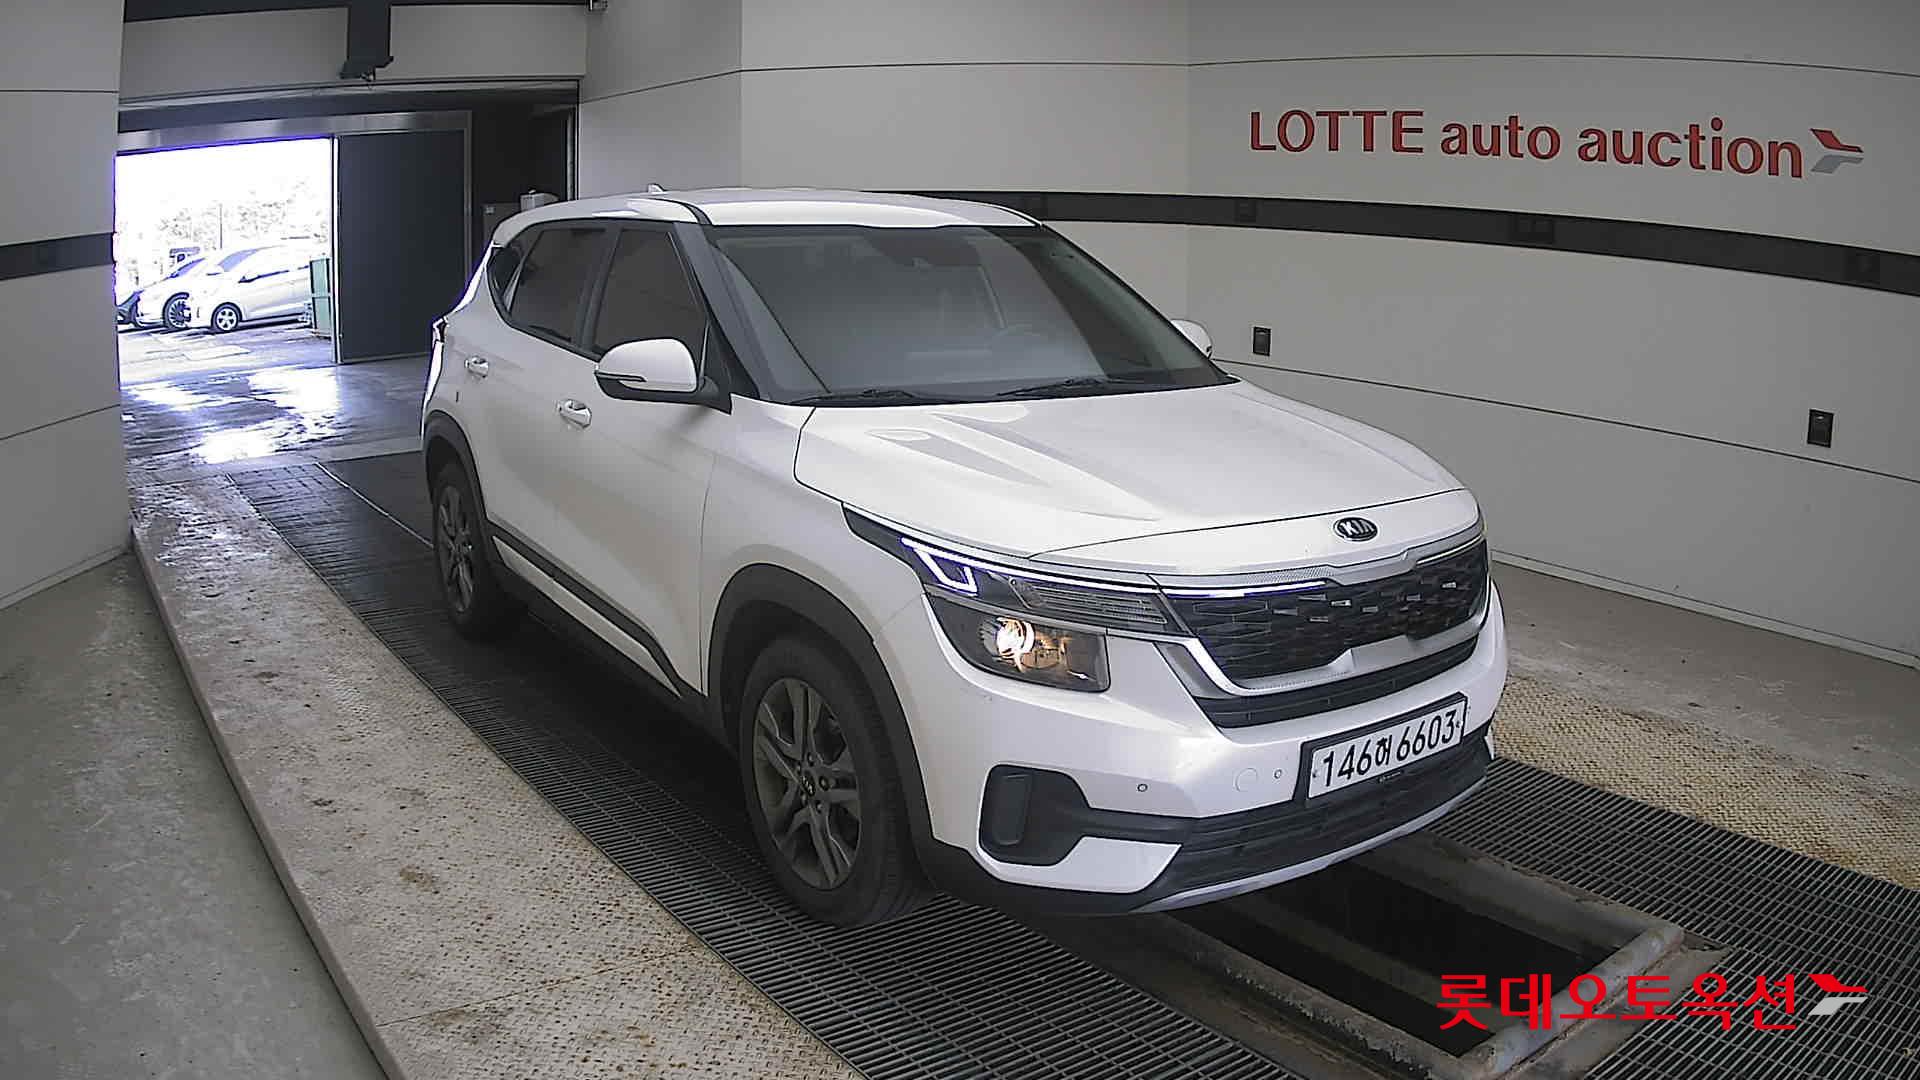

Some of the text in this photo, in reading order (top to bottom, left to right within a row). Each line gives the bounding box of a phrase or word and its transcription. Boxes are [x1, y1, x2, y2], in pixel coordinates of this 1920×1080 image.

[1250, 110, 1803, 179] LOTTE auto auction
[1338, 519, 1375, 536] KIA
